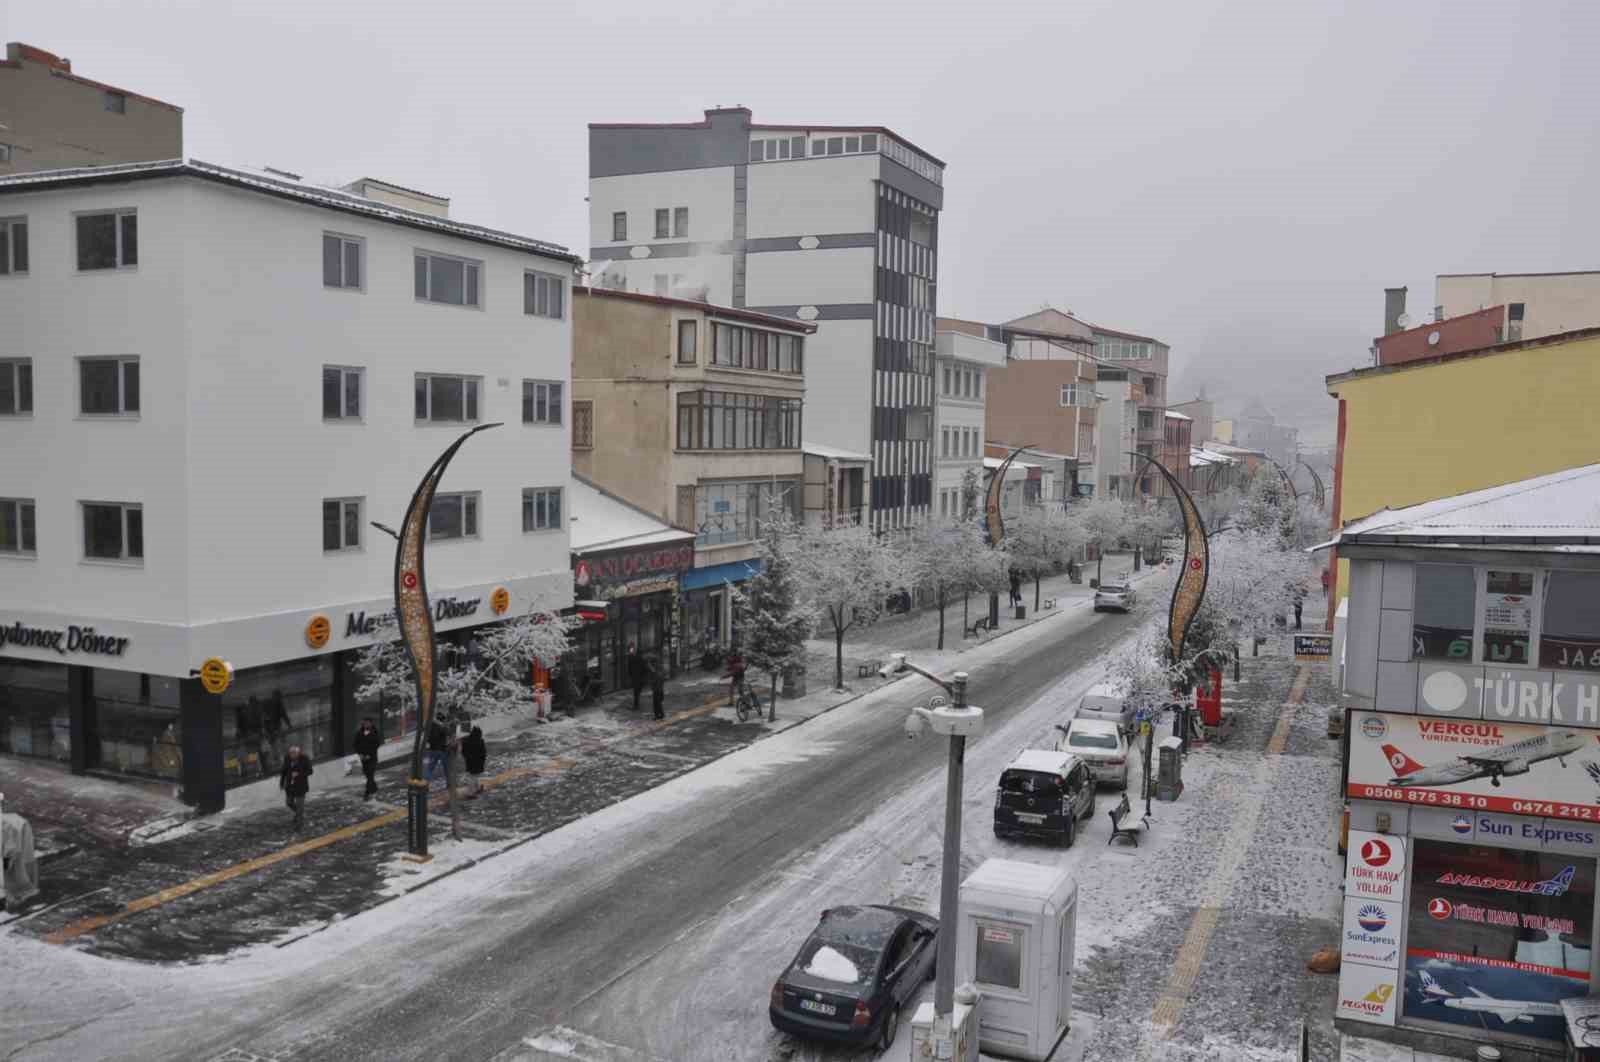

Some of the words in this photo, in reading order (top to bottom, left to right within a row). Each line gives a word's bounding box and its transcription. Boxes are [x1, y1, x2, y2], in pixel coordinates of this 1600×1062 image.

[67, 624, 128, 655] Döner
[1474, 674, 1564, 720] TÜRK
[1365, 787, 1403, 800] 0506
[1408, 790, 1436, 802] 875
[1441, 793, 1462, 805] 38
[1468, 797, 1488, 807] 10
[1512, 801, 1554, 814] 0474
[1559, 806, 1592, 818] 212
[1479, 819, 1513, 836] Sun
[1521, 824, 1594, 846] Express
[1351, 866, 1374, 882] TÜRK
[1376, 871, 1400, 883] HAVA
[1453, 903, 1486, 923] TÜRK
[1488, 908, 1519, 928] HAVA
[1347, 931, 1396, 945] SunExpress
